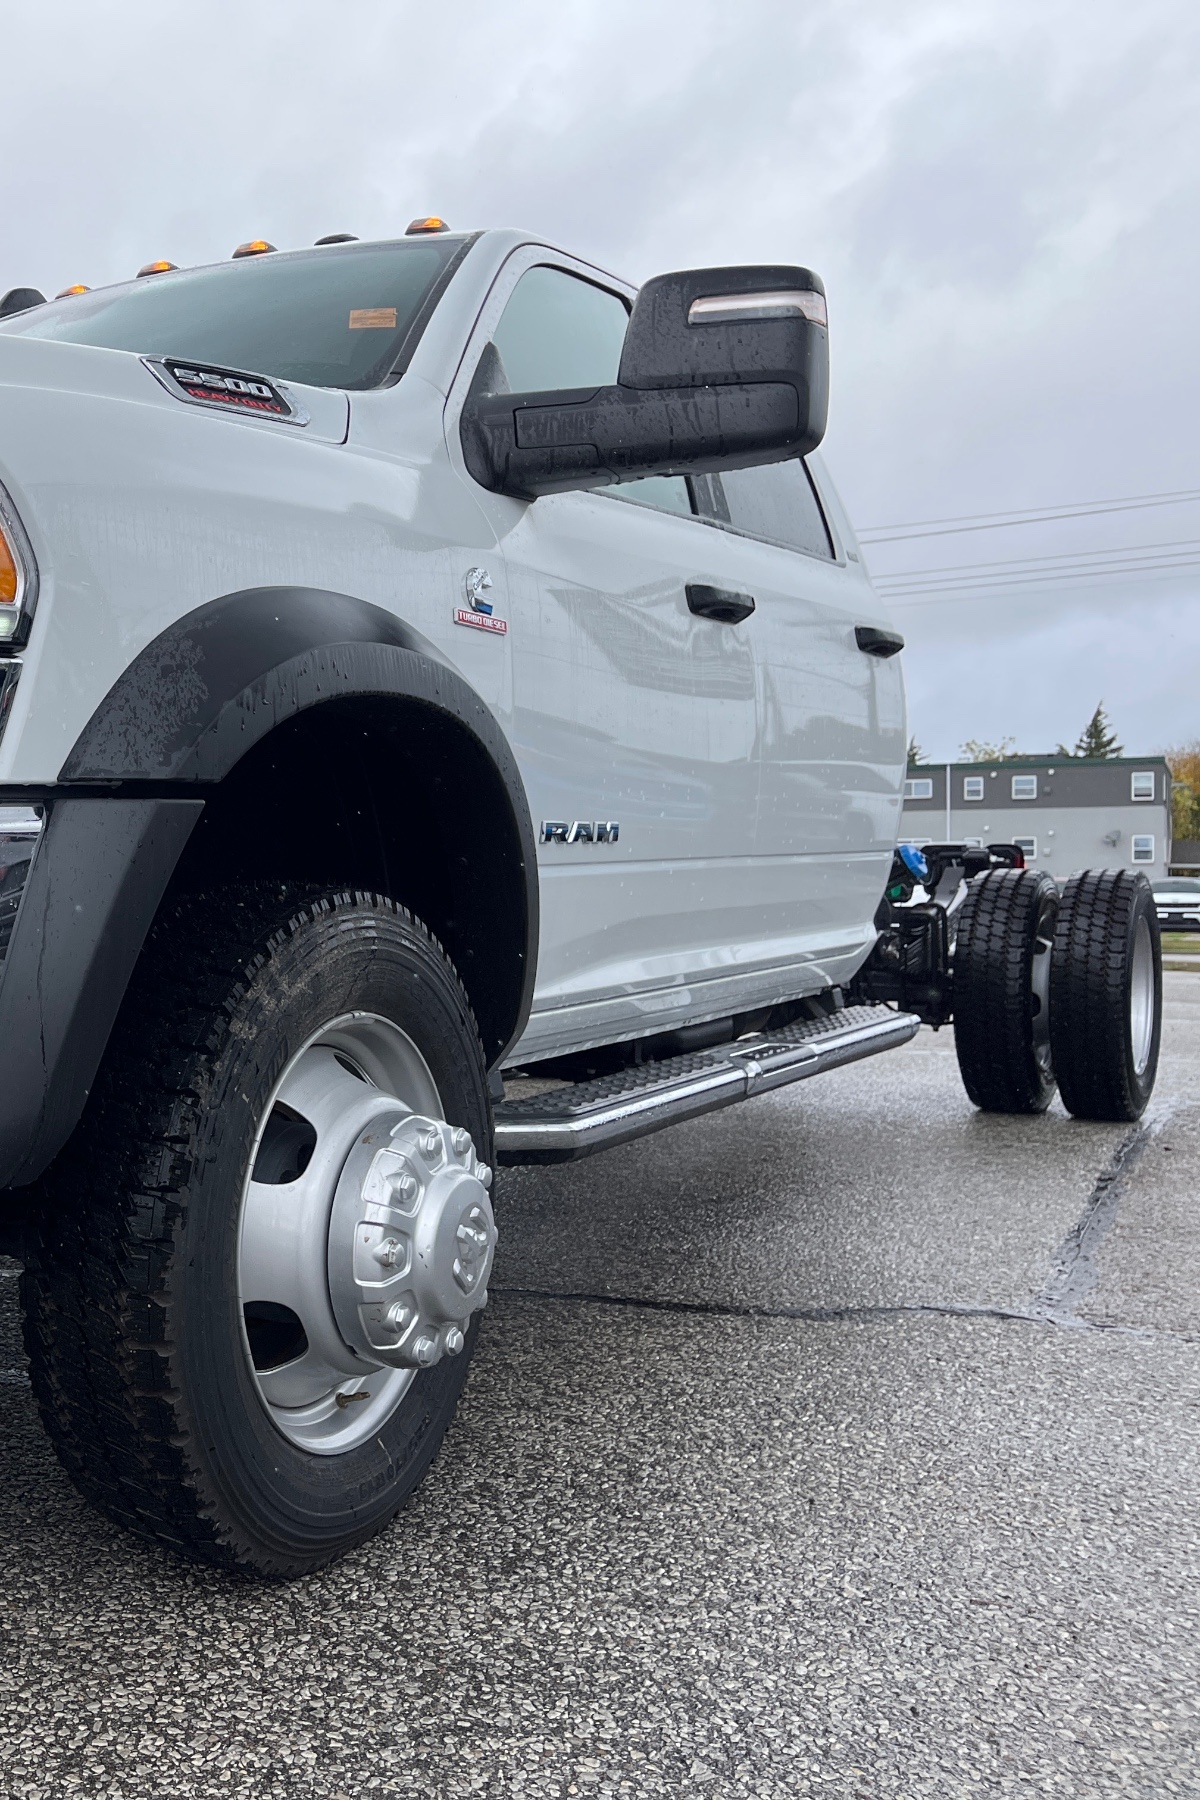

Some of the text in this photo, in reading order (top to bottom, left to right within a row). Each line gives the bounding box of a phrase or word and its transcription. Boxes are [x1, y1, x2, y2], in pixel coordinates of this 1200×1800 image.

[174, 368, 273, 400] 5500
[188, 388, 282, 412] HEAVY DUTY
[459, 611, 506, 631] TURBO DIESEL
[539, 820, 620, 844] RAM
